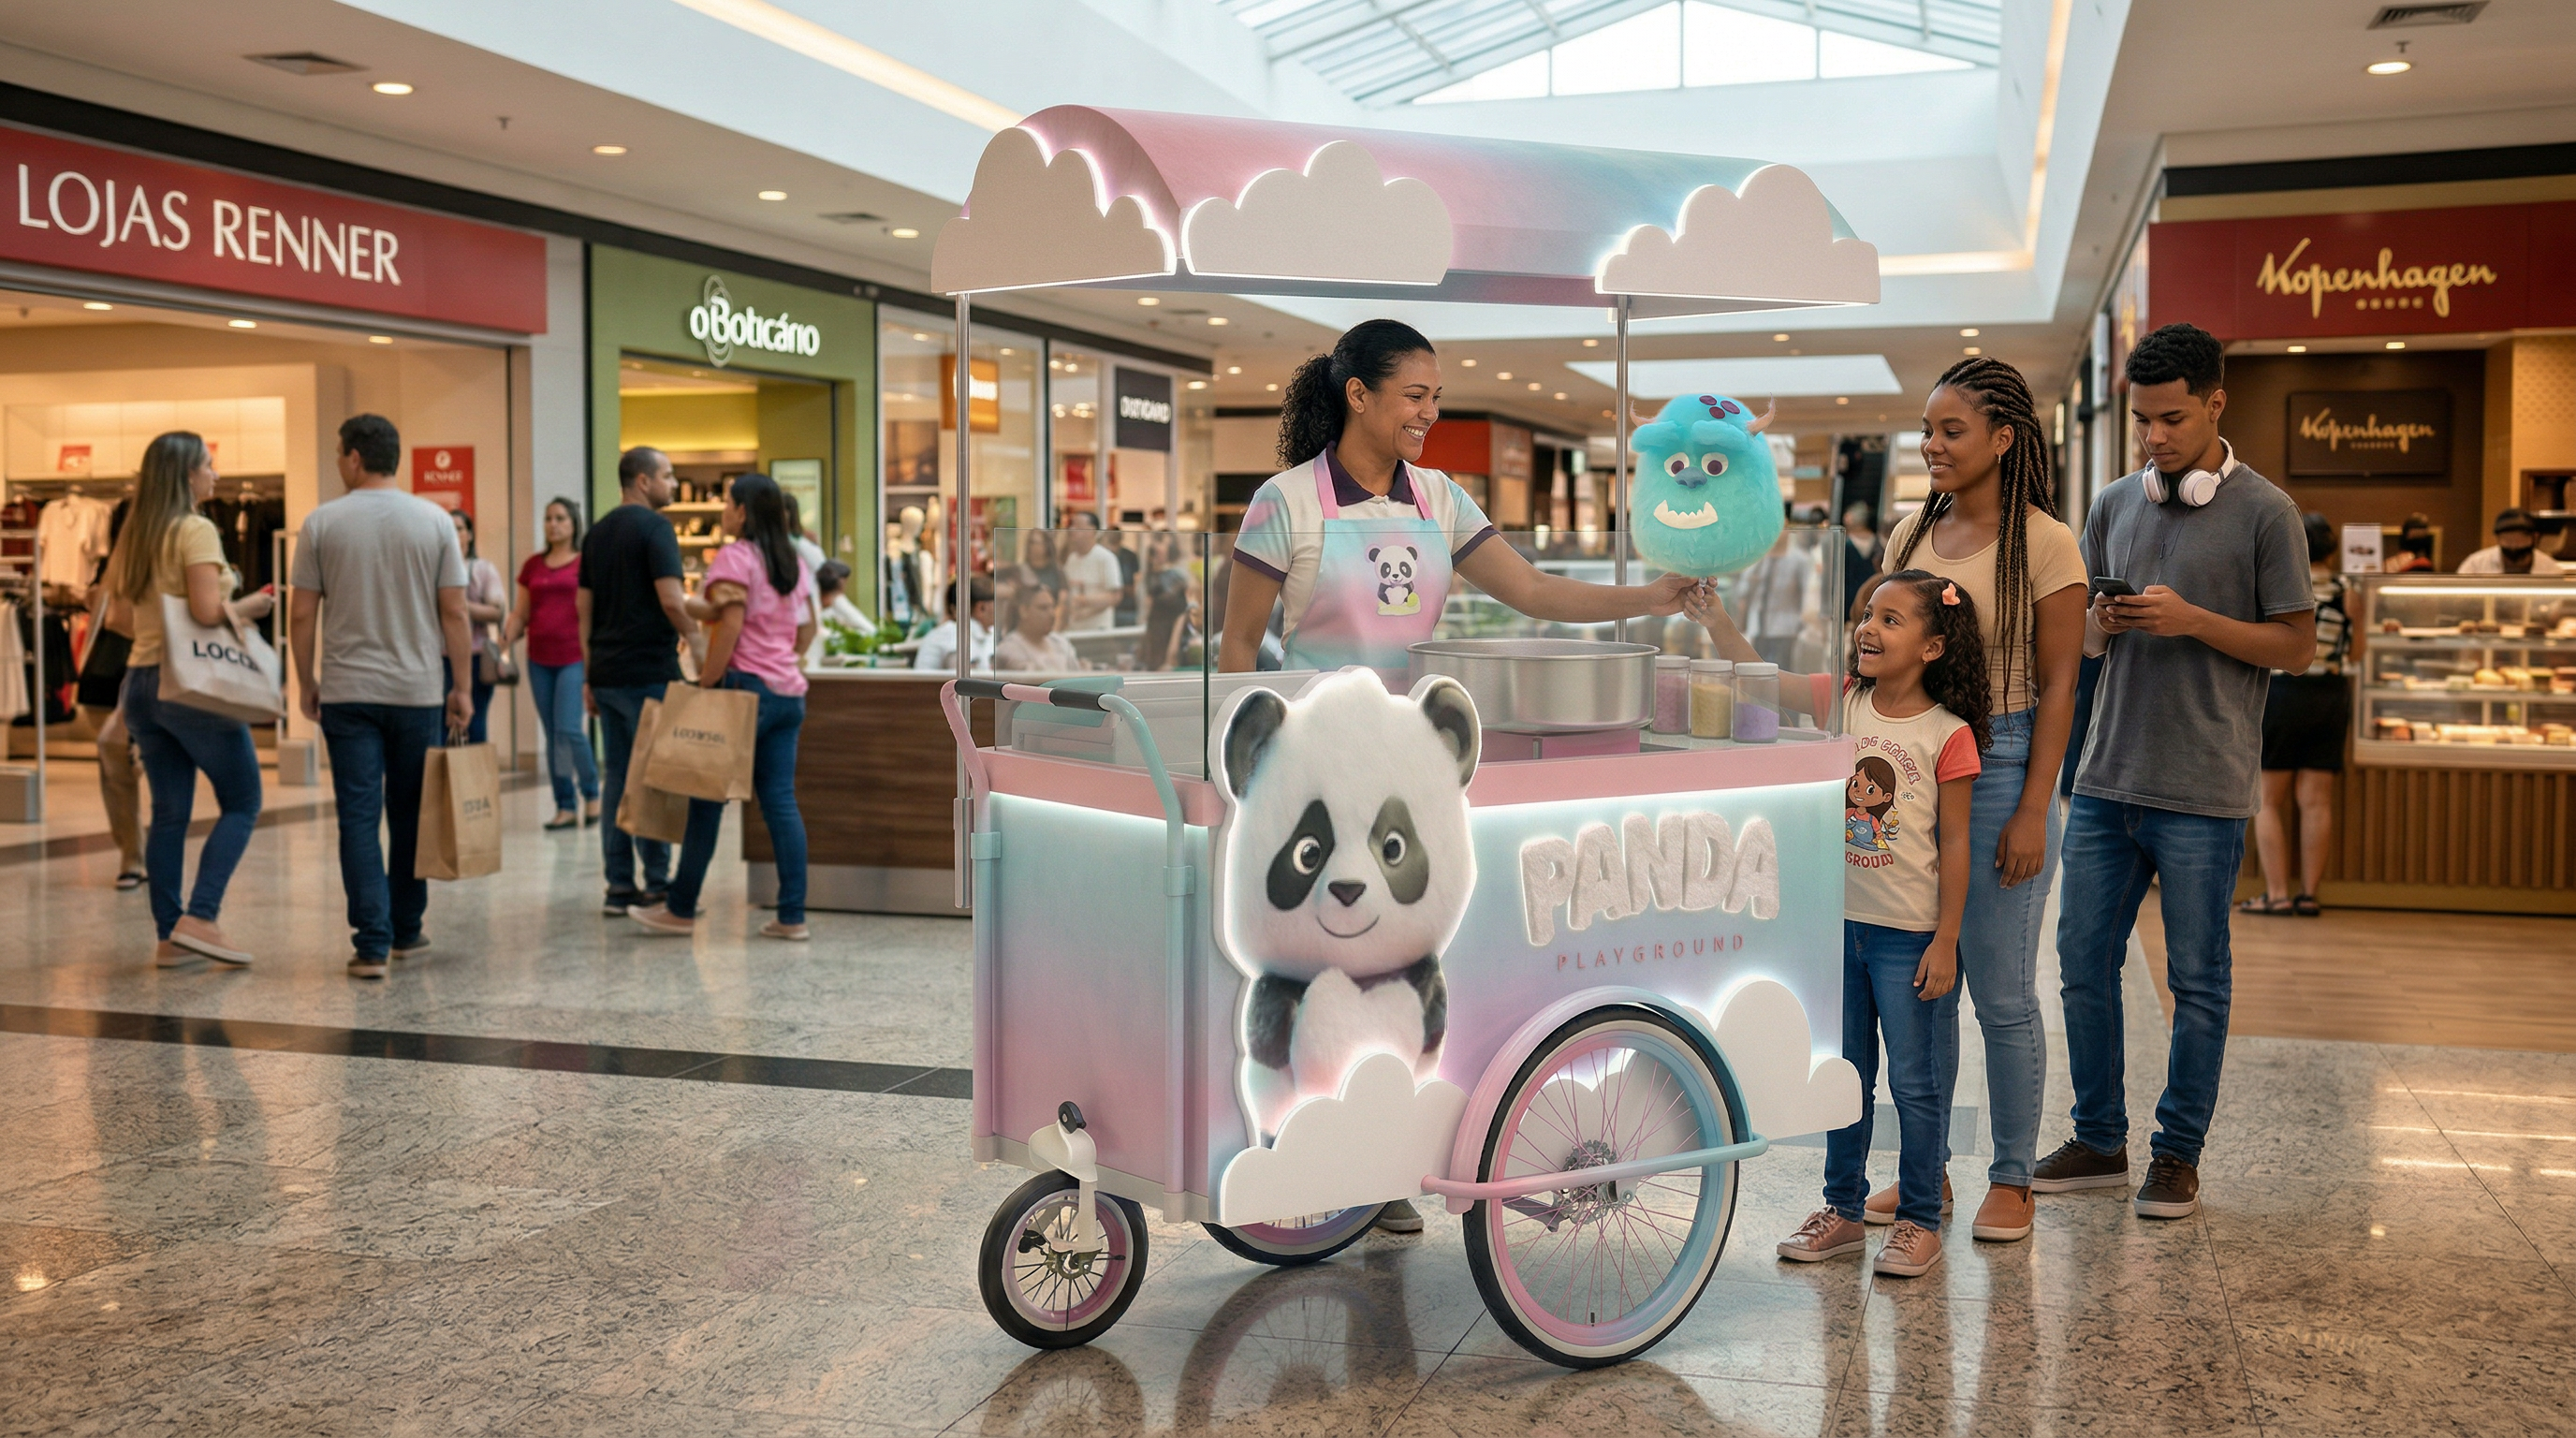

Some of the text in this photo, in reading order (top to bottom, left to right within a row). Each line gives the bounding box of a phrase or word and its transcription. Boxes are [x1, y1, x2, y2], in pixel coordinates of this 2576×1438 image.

[18, 163, 402, 286] LOJAS RENNER
[2257, 238, 2497, 319] Kopenhagen
[1519, 811, 1780, 946] PANDA
[1558, 933, 1745, 971] PLAYGROUND
